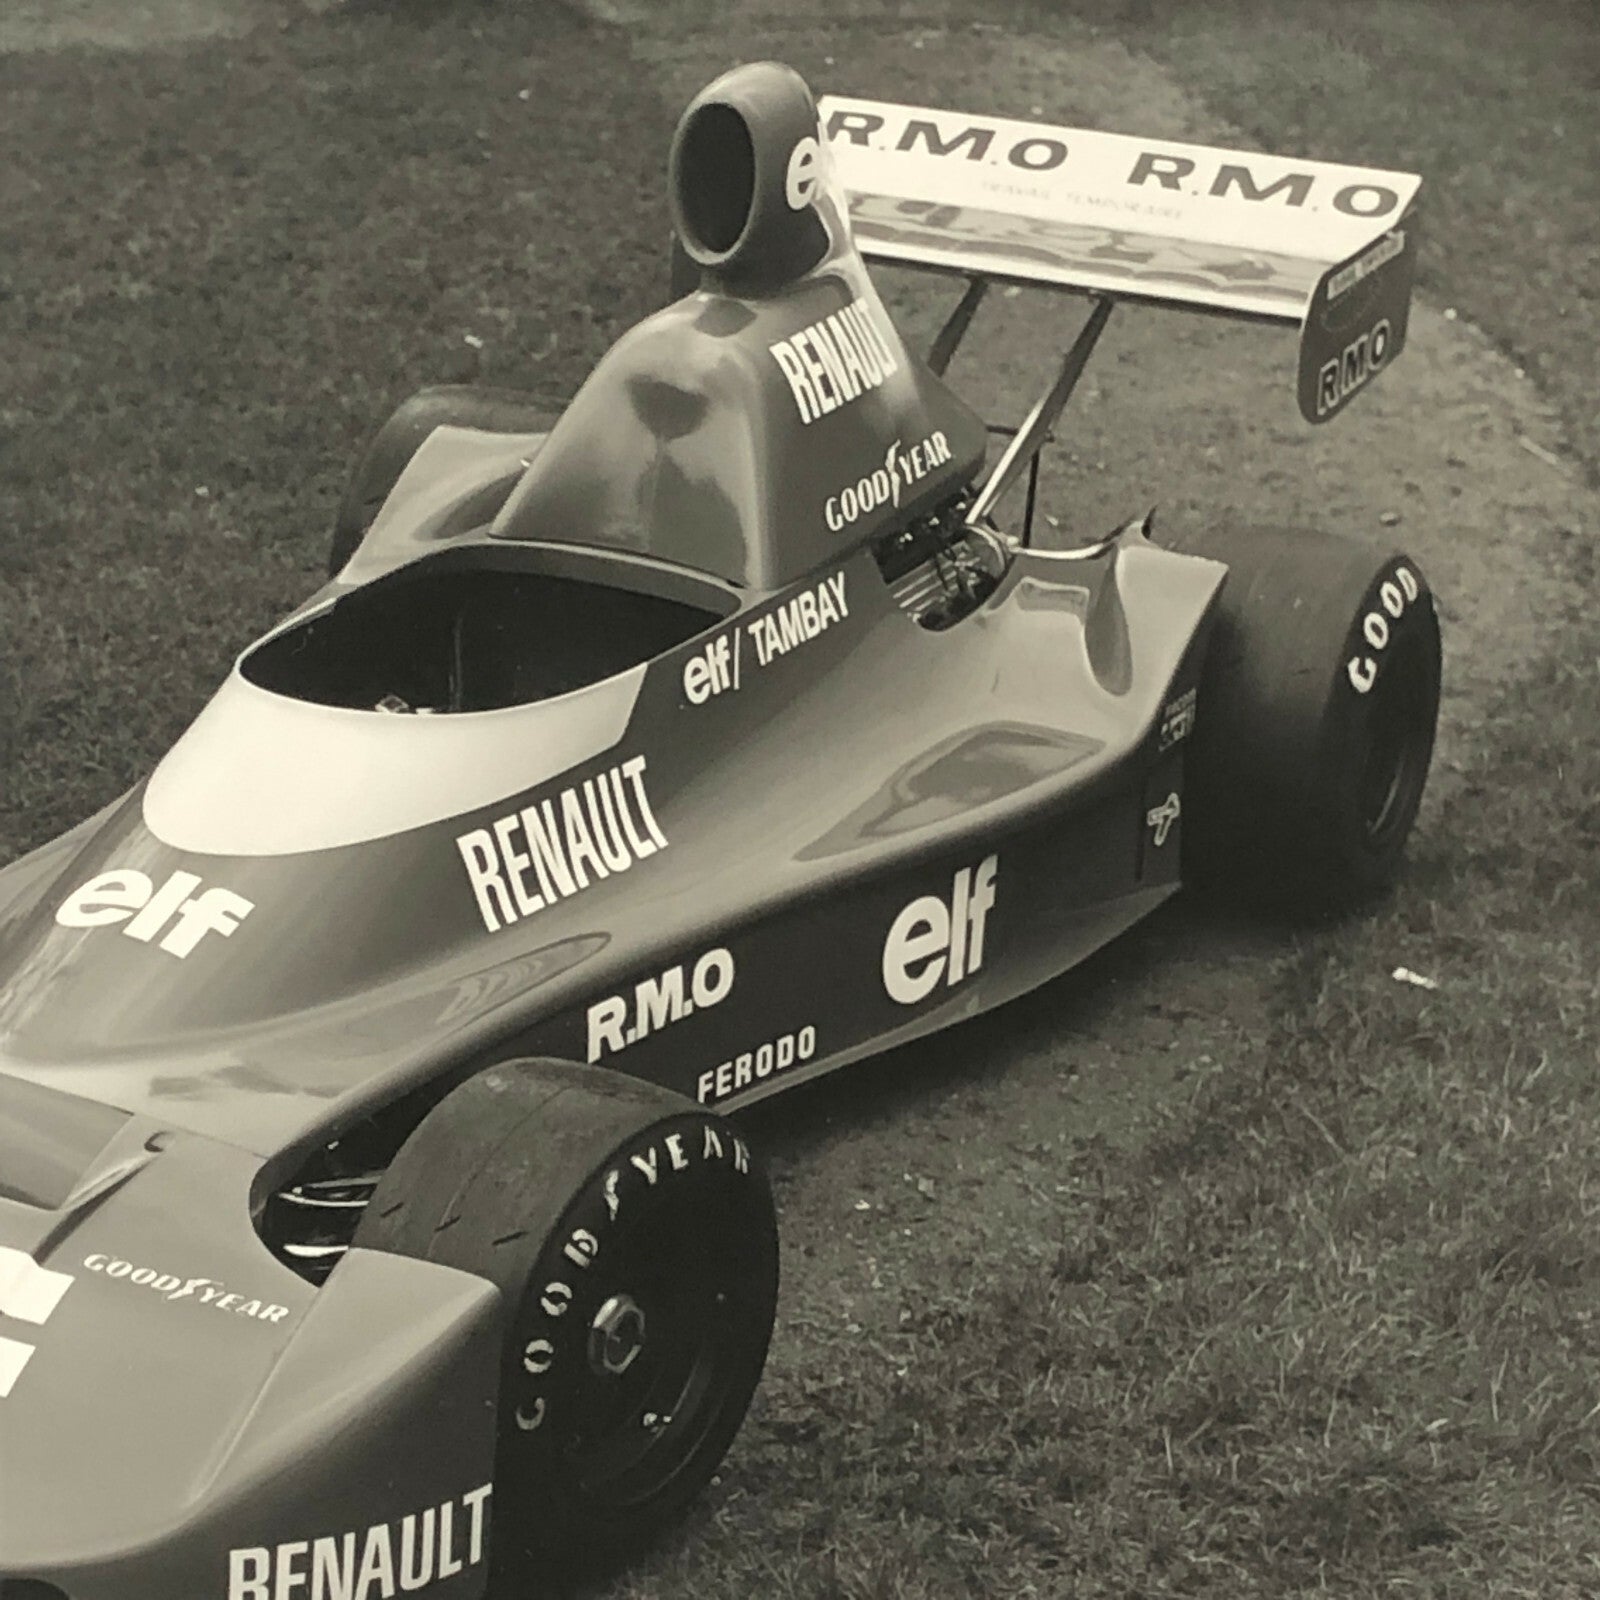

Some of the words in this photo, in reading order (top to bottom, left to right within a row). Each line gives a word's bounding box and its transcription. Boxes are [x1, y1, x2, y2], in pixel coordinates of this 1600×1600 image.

[826, 110, 1069, 172] R.M.O
[1127, 151, 1399, 218] R.M.O
[769, 297, 898, 425] RENAULT
[747, 570, 849, 667] TAMBAY
[455, 754, 670, 934] RENAULT
[54, 868, 256, 960] elf
[882, 853, 999, 1005] elf
[586, 946, 736, 1064] R.M.O
[697, 1024, 817, 1104] FERODO
[227, 1481, 494, 1600] RENAULT
